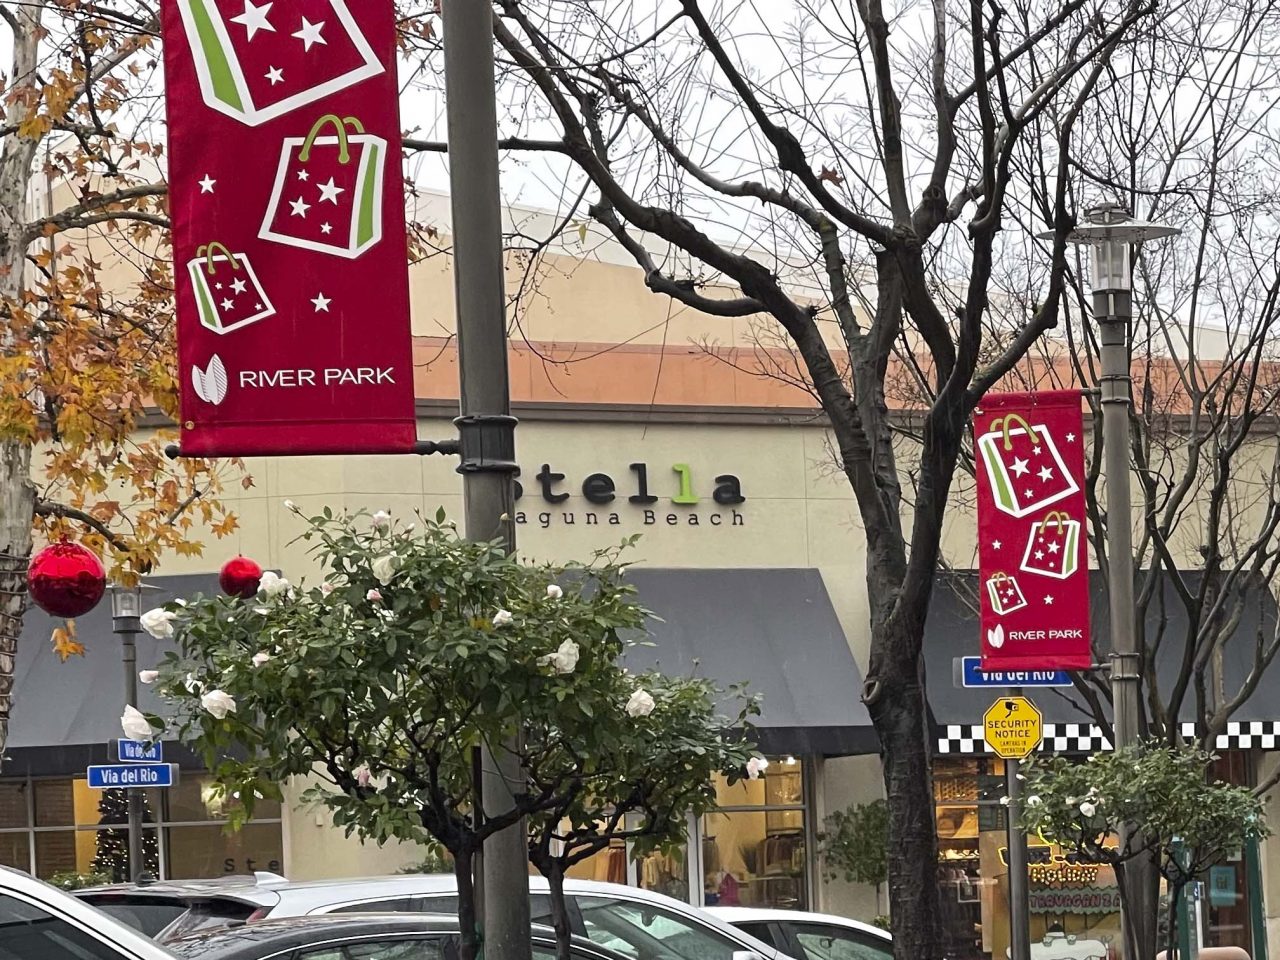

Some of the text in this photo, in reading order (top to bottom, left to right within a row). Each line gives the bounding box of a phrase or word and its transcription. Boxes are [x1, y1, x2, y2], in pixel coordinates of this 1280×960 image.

[239, 367, 396, 388] RIVER PARK
[515, 510, 744, 529] aguna Beach
[1009, 629, 1083, 640] RIVER PARK
[988, 720, 1037, 729] SECURITY
[995, 729, 1031, 739] NOTICE
[101, 768, 158, 784] Via del Rio
